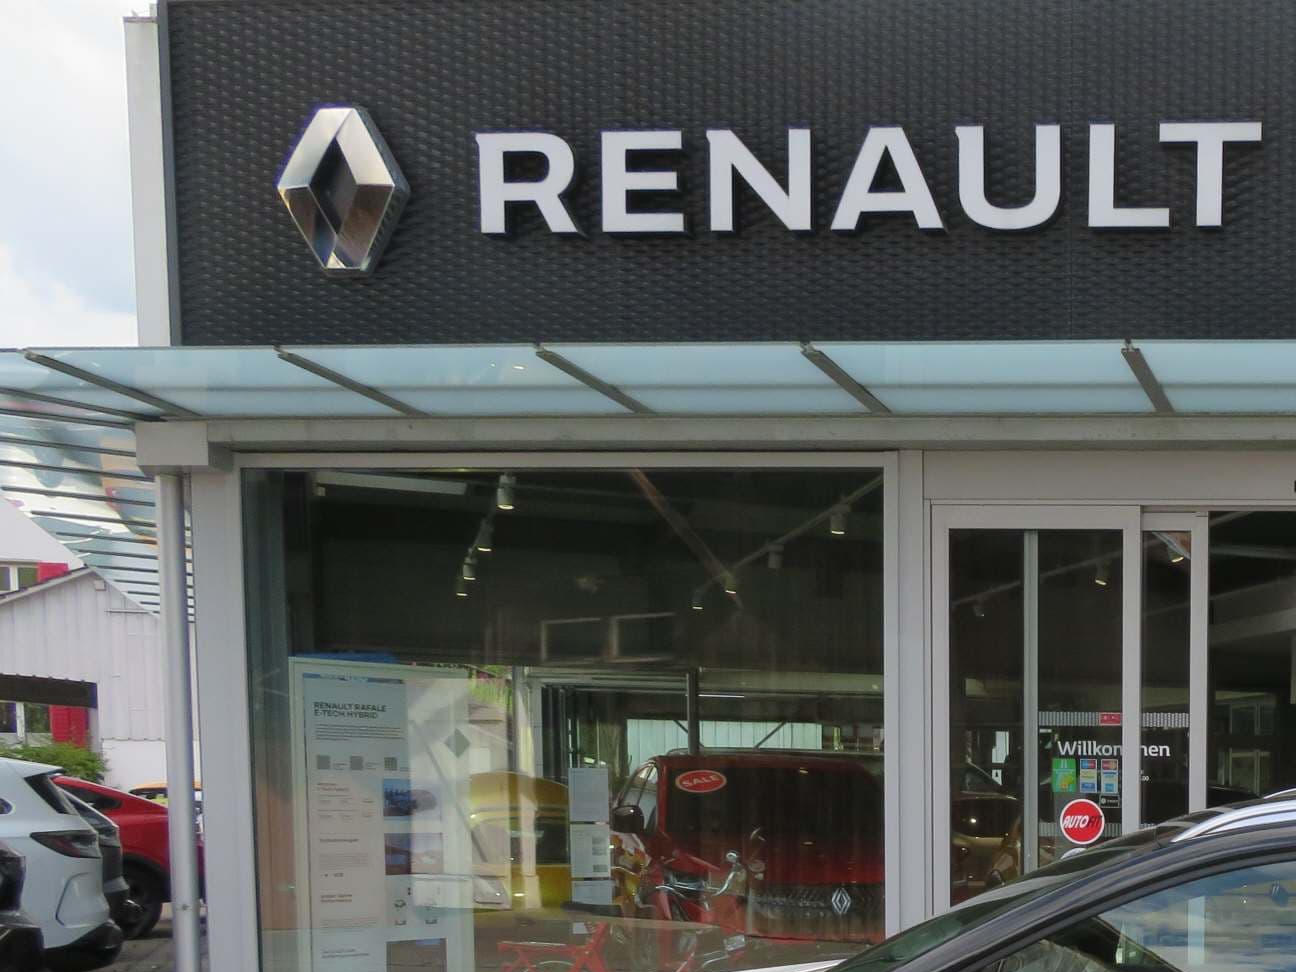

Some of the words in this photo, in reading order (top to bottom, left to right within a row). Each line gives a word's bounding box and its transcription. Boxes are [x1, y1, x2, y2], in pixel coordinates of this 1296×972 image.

[476, 122, 1262, 233] RENAULT
[313, 702, 353, 711] RENAULT
[346, 711, 378, 720] HYBRID
[682, 774, 720, 788] SALE
